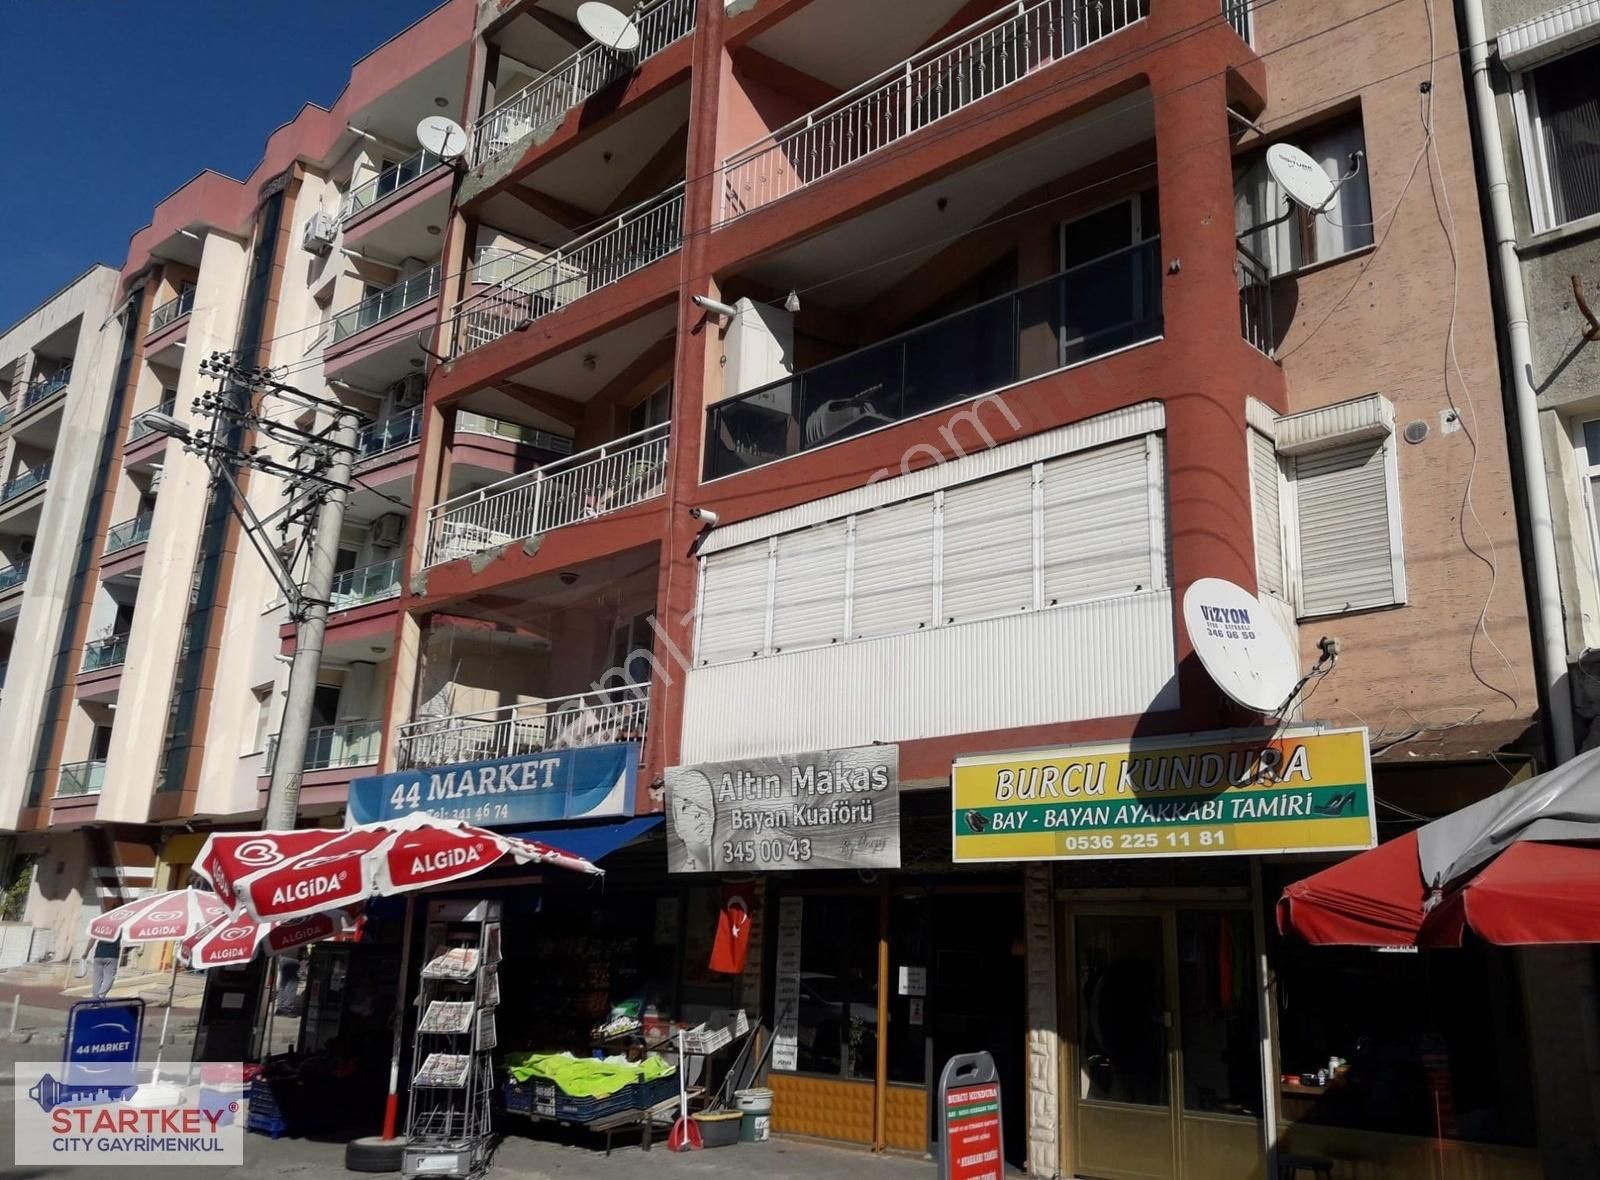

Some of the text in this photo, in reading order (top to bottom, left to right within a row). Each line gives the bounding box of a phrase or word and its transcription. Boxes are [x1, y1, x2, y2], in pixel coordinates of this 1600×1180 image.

[1206, 628, 1224, 638] 346
[390, 757, 560, 811] 44 MARKET
[718, 760, 889, 802] Altın Makas
[995, 746, 1312, 801] BURCU KUNDURA
[475, 802, 490, 820] 46
[494, 803, 508, 818] 74
[731, 799, 873, 834] Bayan Kuaförü
[992, 811, 1027, 830] BAY
[1044, 805, 1112, 828] BAYAN
[1119, 799, 1223, 826] AYAKKABI
[1230, 791, 1313, 819] TAMİRİ
[723, 837, 812, 864] 345 00 43
[1065, 830, 1225, 851] 0536 225 11 81
[76, 1041, 130, 1054] 44 MARKET
